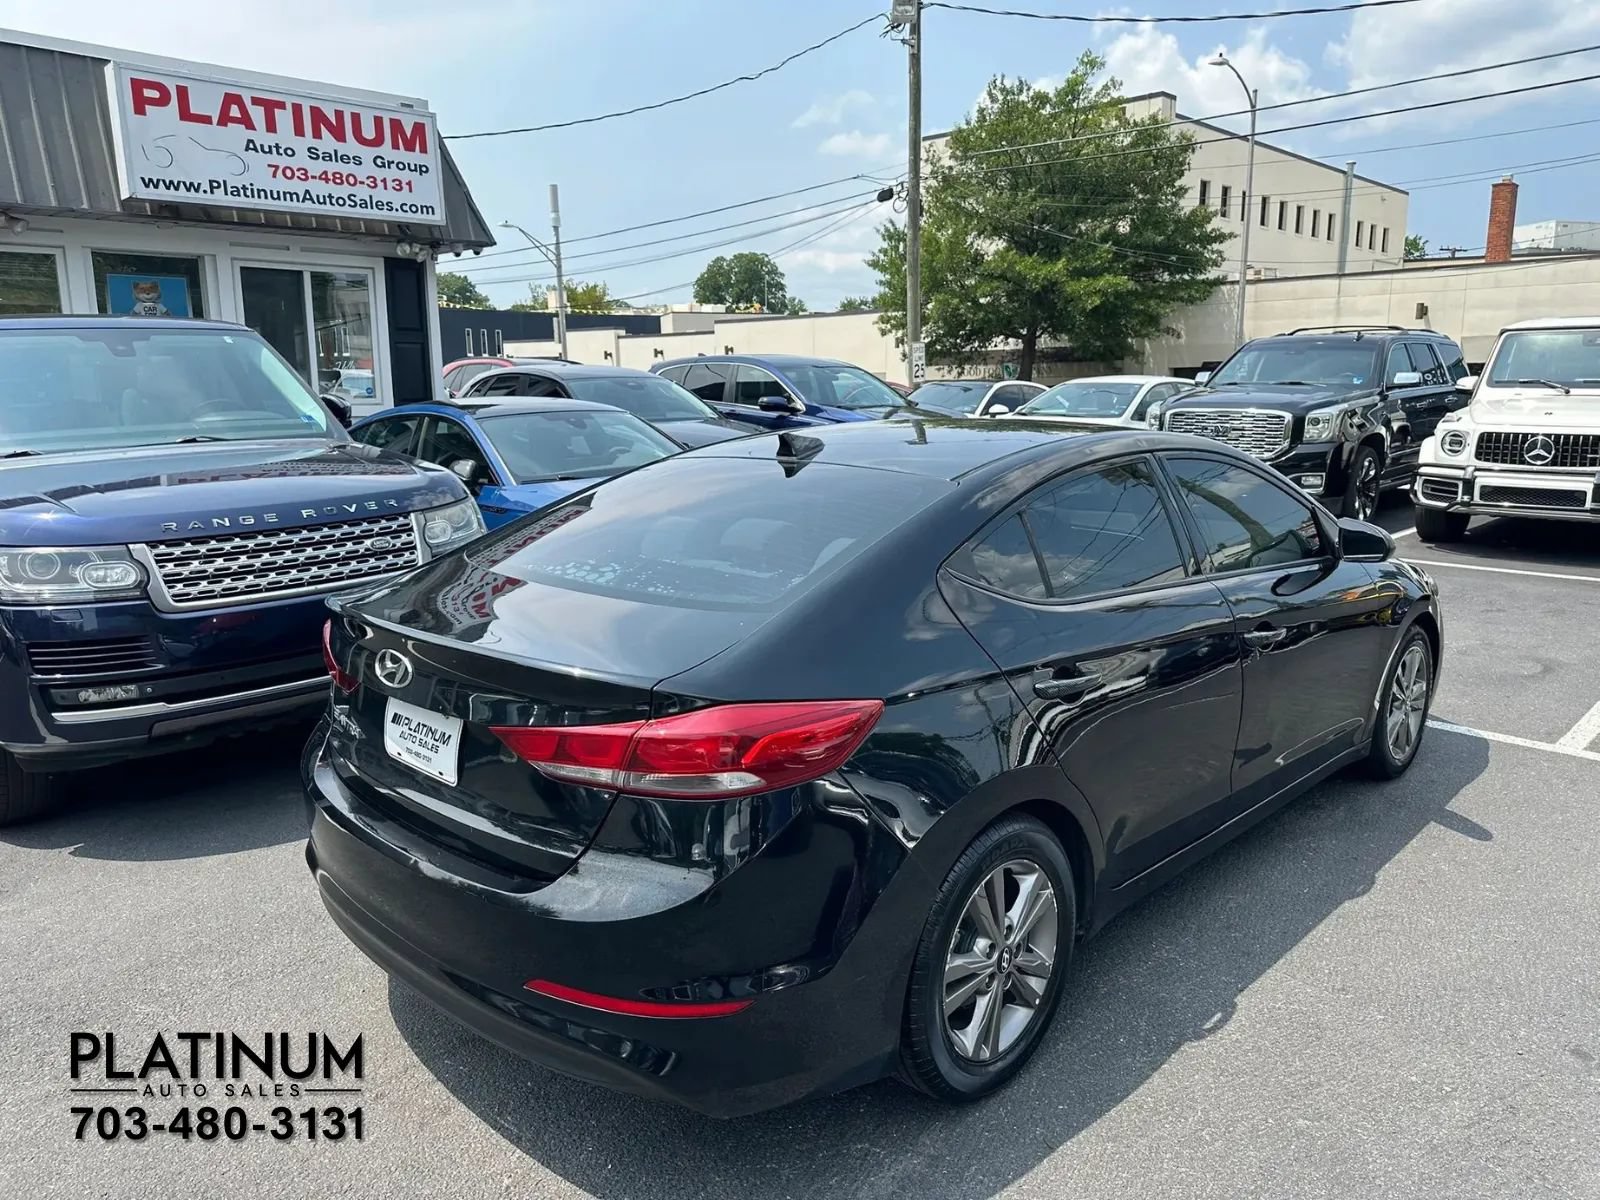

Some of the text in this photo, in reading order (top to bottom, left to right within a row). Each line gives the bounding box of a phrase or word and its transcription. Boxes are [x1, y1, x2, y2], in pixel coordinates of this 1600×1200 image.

[129, 77, 429, 154] PLATINUM
[244, 138, 430, 176] Auto Sales Group
[267, 163, 414, 194] 703-480-3131
[140, 176, 436, 216] www.PlatinumAutoSales.com
[914, 363, 924, 378] 25
[160, 498, 399, 533] RANGE ROVER
[399, 730, 440, 754] AUTO SALES
[401, 717, 452, 747] PLATINUM
